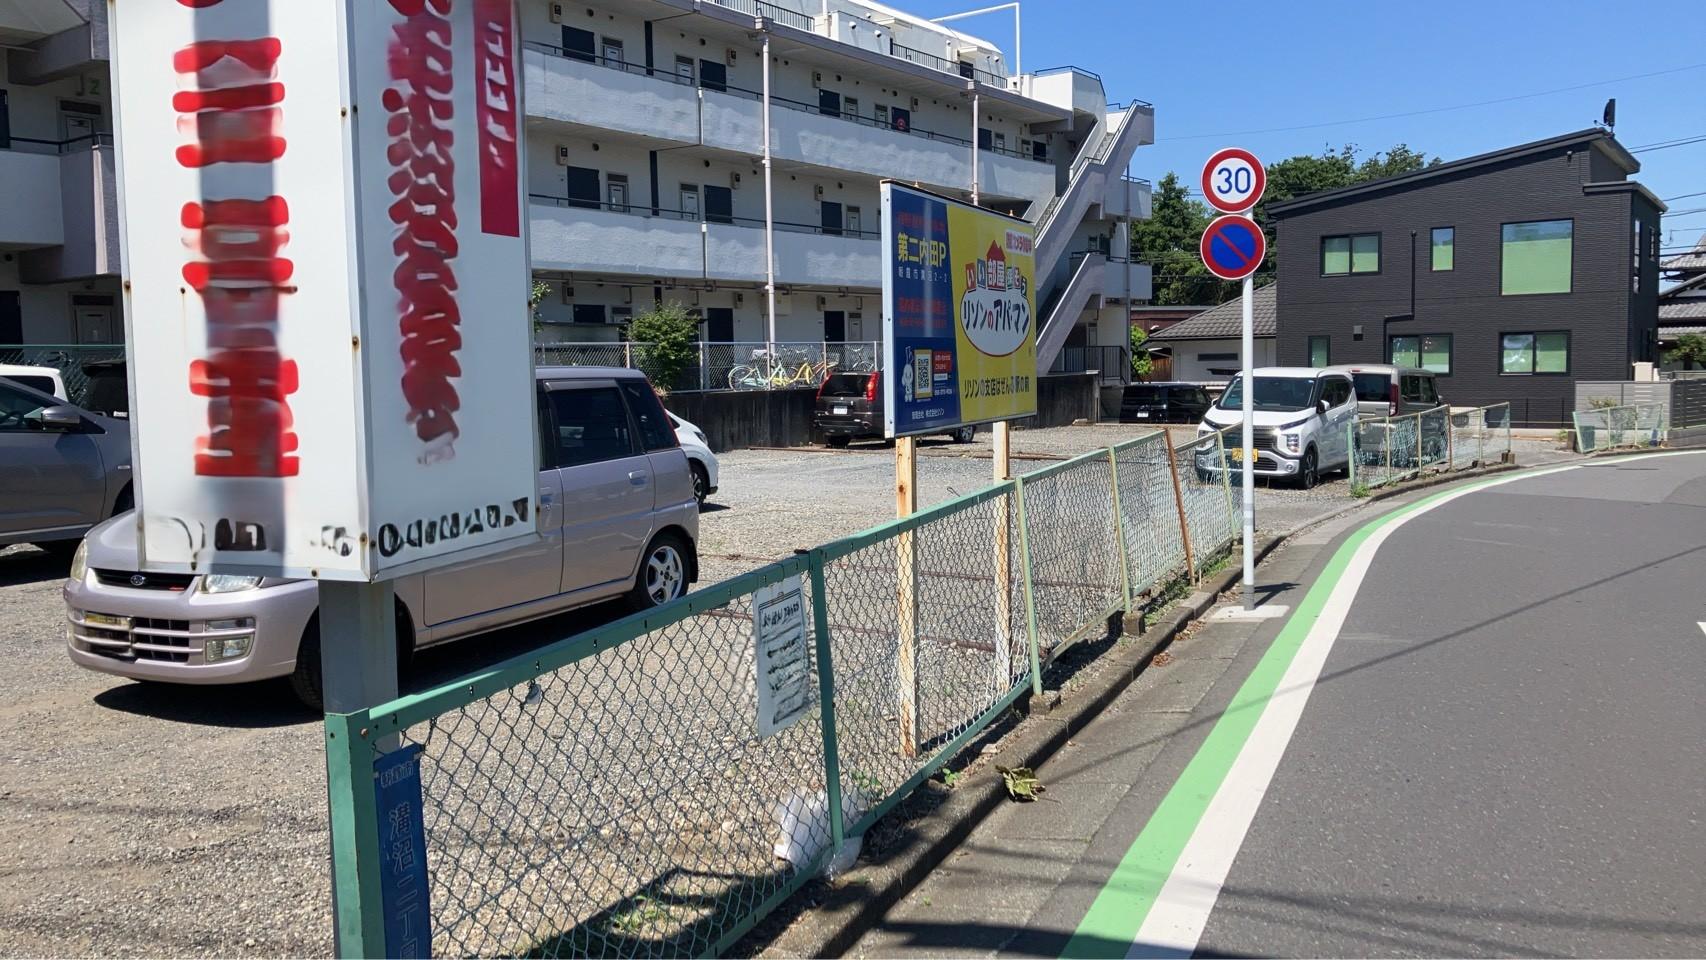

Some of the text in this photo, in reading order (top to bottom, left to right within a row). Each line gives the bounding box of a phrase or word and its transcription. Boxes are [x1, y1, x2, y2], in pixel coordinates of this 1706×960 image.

[1216, 166, 1251, 195] 30
[897, 231, 947, 267] 第二内田P
